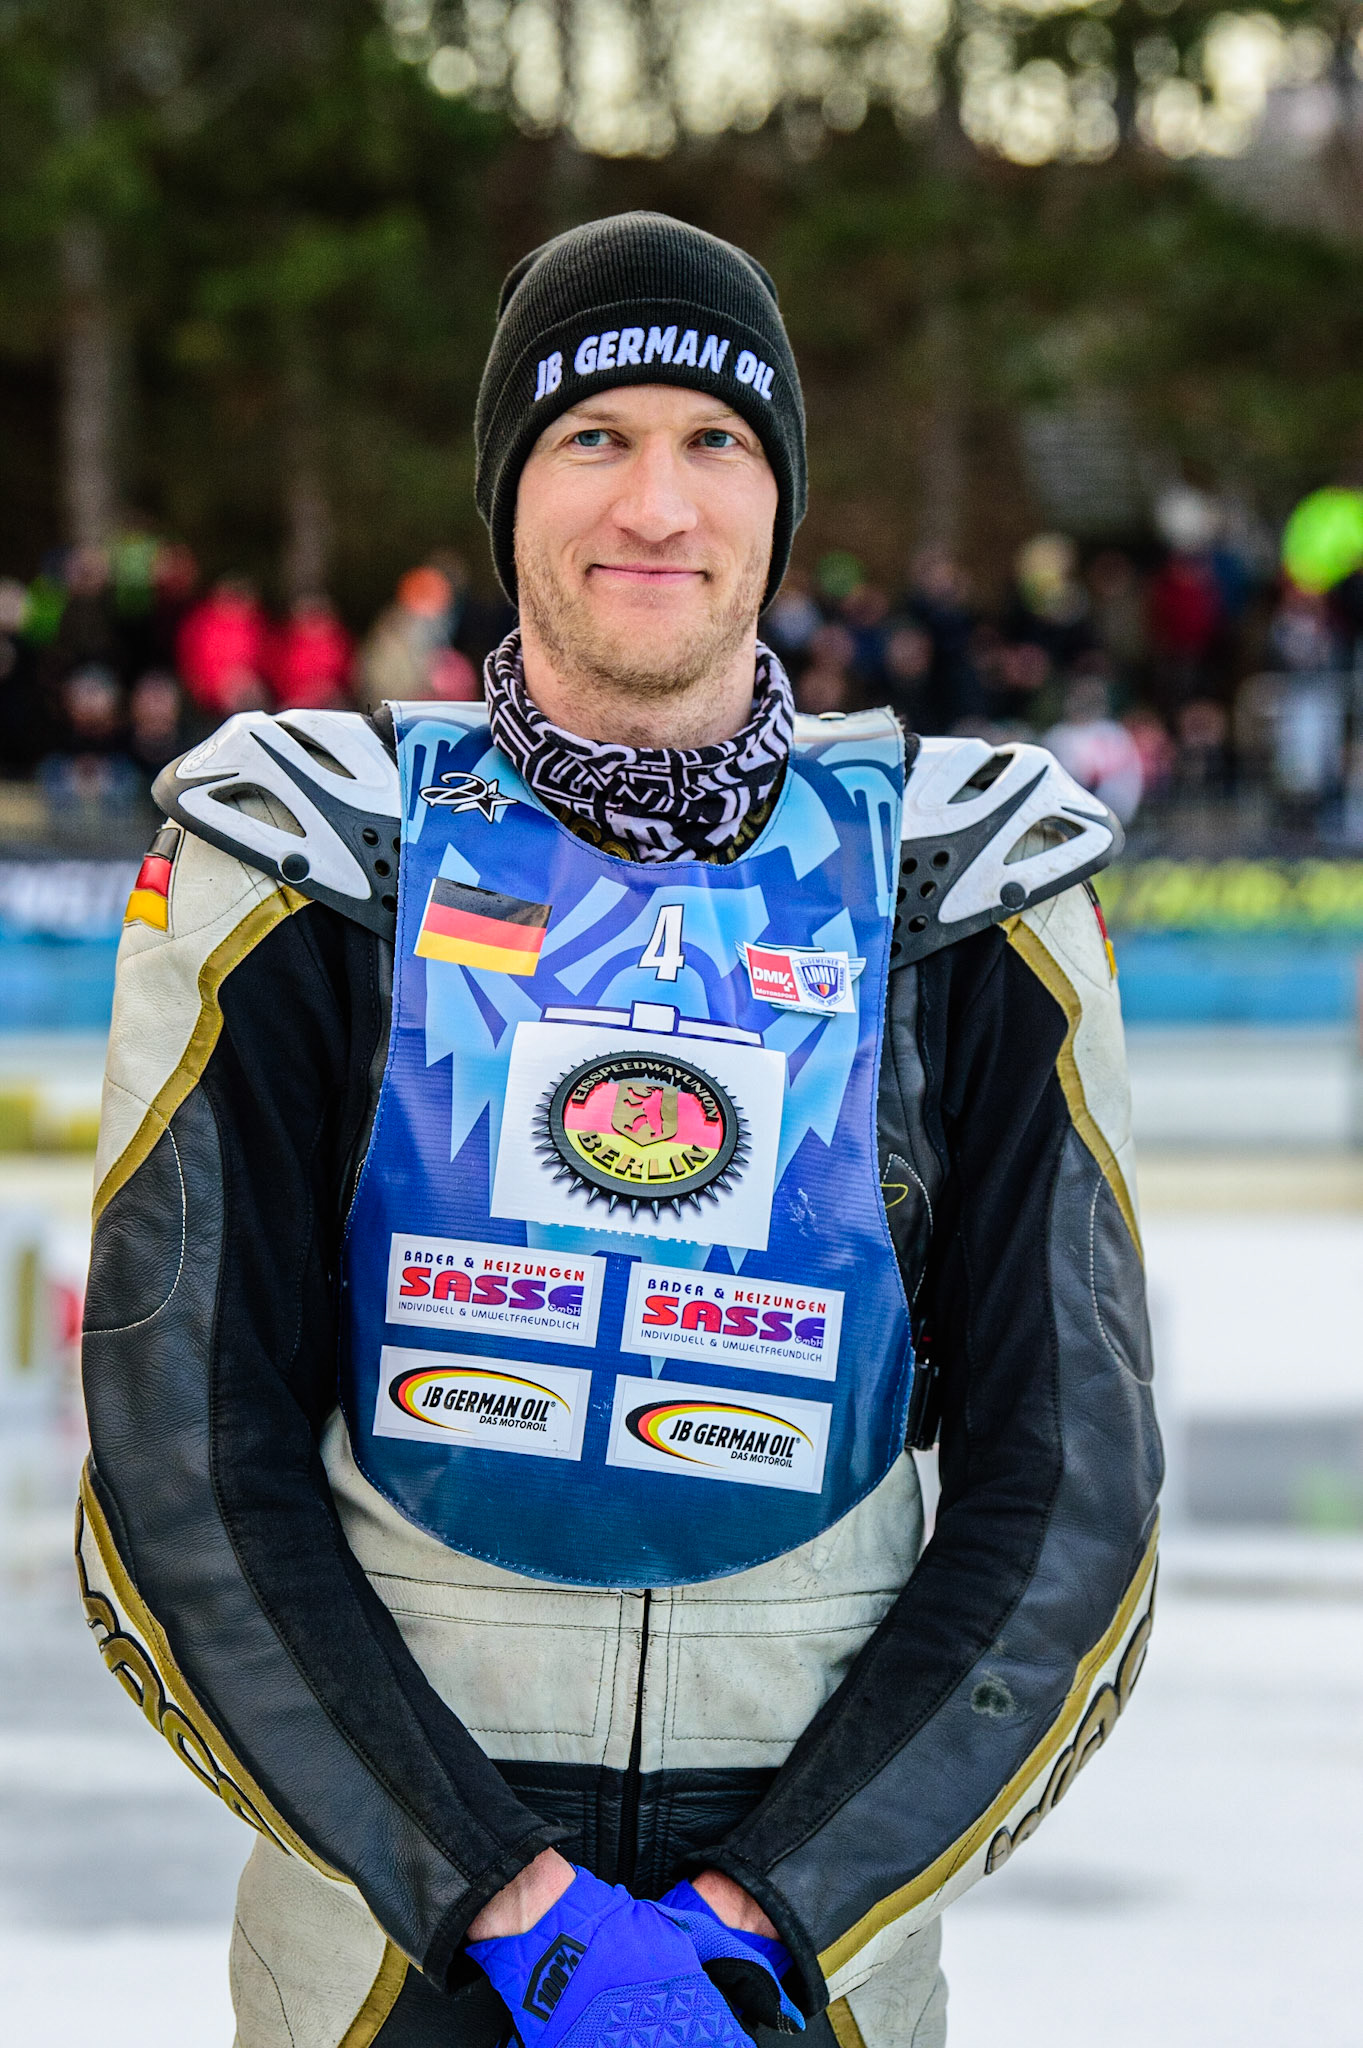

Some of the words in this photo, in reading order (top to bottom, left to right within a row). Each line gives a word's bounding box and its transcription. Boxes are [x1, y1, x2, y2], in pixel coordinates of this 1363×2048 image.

[534, 351, 563, 402] JB
[574, 325, 730, 376] GERMAN
[735, 349, 775, 400] OIL
[638, 904, 685, 982] 4
[752, 966, 790, 985] DMV
[803, 965, 838, 985] ADMV
[756, 988, 797, 999] MOTORSPORT
[572, 1061, 720, 1123] EISSPEEDWAYUNION
[577, 1130, 710, 1179] BERLIN
[464, 1257, 474, 1268] &
[484, 1259, 585, 1281] HEIZUNGEN
[399, 1266, 585, 1316] SASSE
[714, 1288, 724, 1299] &
[734, 1290, 826, 1314] HEIZUNGEN
[398, 1301, 455, 1316] INDIVIDUELL
[459, 1308, 467, 1316] &
[471, 1309, 580, 1331] UMWELTFREUNDLICH
[548, 1303, 582, 1316] GmbH
[642, 1294, 826, 1348] SASSE
[640, 1330, 705, 1346] INDIVIDUELL
[709, 1338, 718, 1347] &
[722, 1340, 823, 1363] UMWELTFREUNDLICH
[794, 1335, 824, 1349] GmbH
[422, 1386, 444, 1408] JB
[443, 1388, 522, 1417] GERMAN
[479, 1415, 498, 1426] DAS
[498, 1417, 547, 1432] MOTOROIL
[669, 1419, 693, 1442] JB
[694, 1423, 771, 1453] GERMAN
[730, 1450, 749, 1461] DAS
[749, 1453, 793, 1468] MOTOROIL
[537, 1946, 580, 2011] 100%
